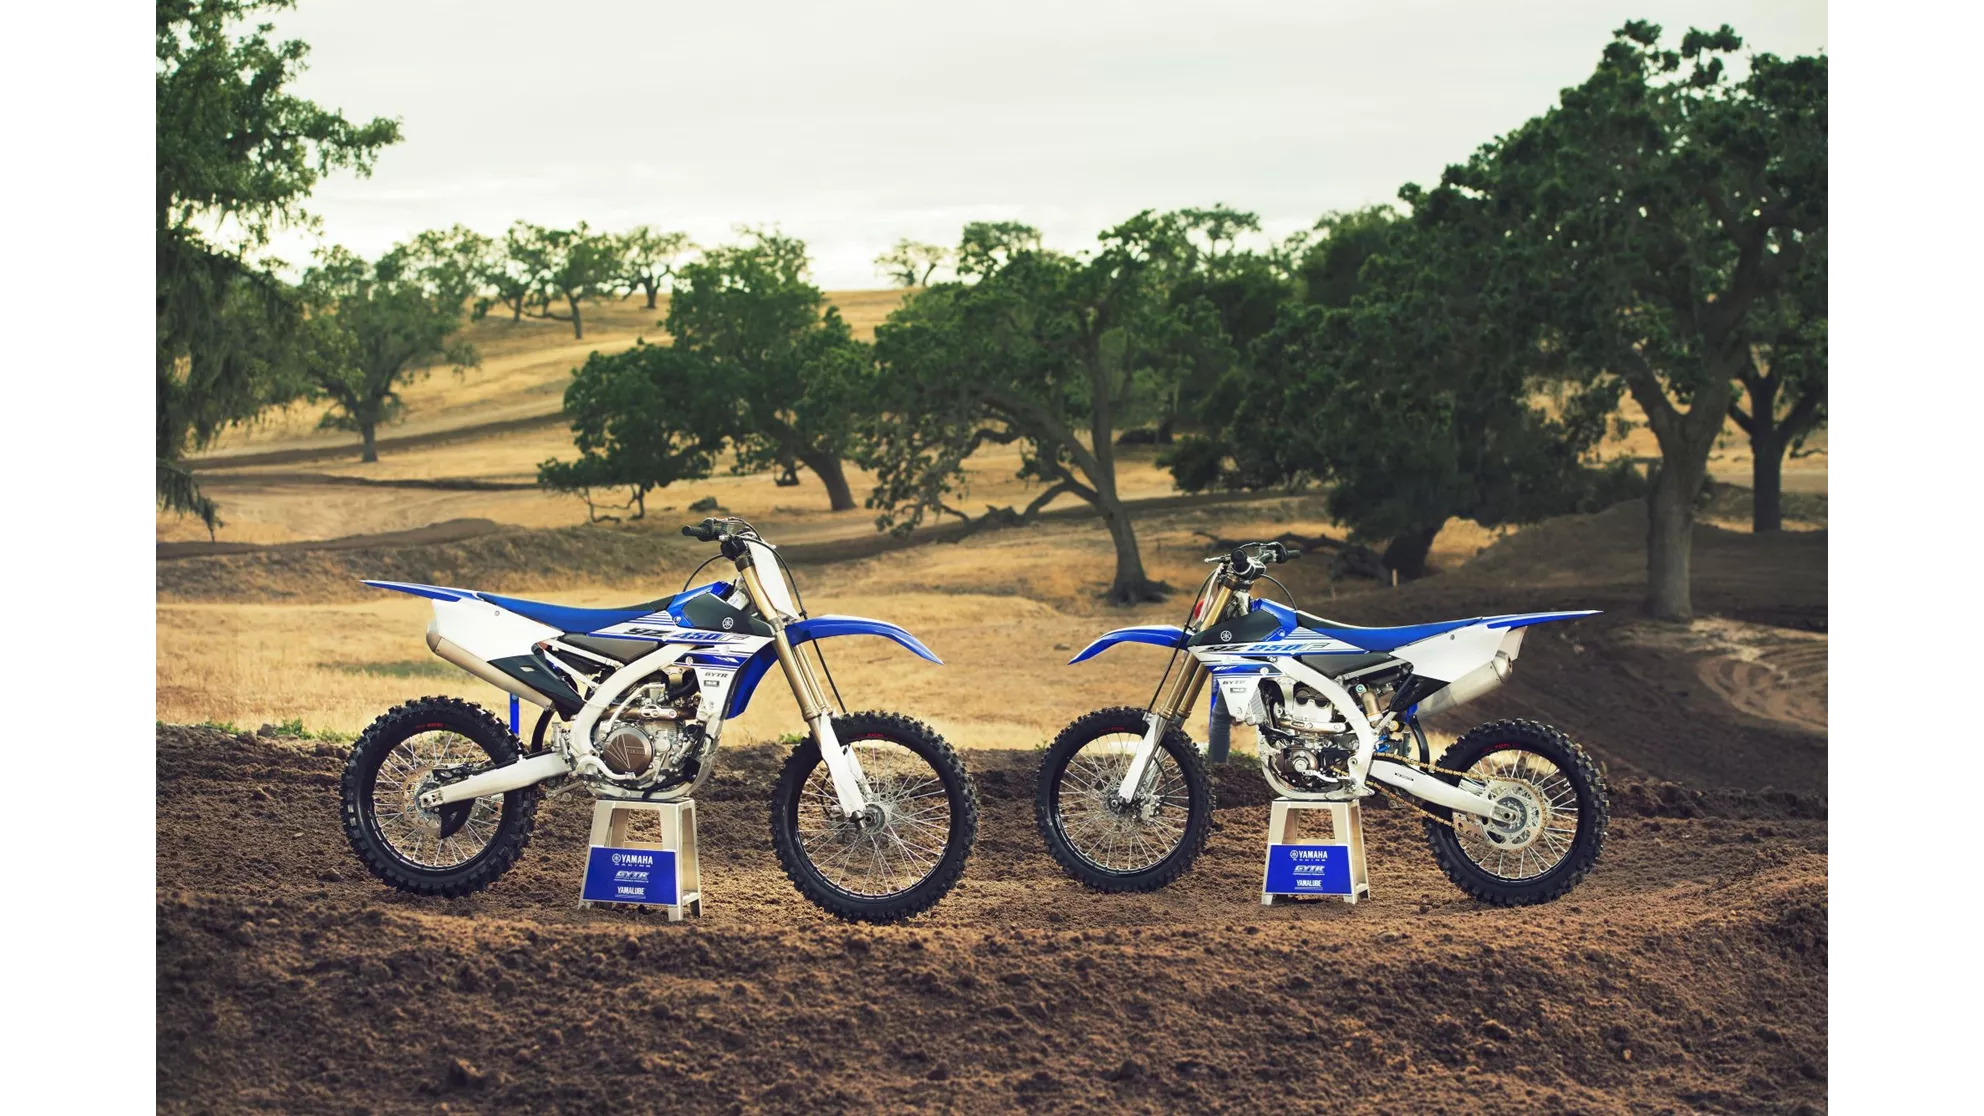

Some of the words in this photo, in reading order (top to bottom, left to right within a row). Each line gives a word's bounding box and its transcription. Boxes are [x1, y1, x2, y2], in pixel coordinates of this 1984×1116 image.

[1299, 850, 1328, 859] YAMAHA
[621, 854, 653, 865] YAMAHA
[1294, 864, 1325, 873] GYTR
[615, 870, 649, 879] GYTR
[617, 886, 645, 895] YAMALUBE
